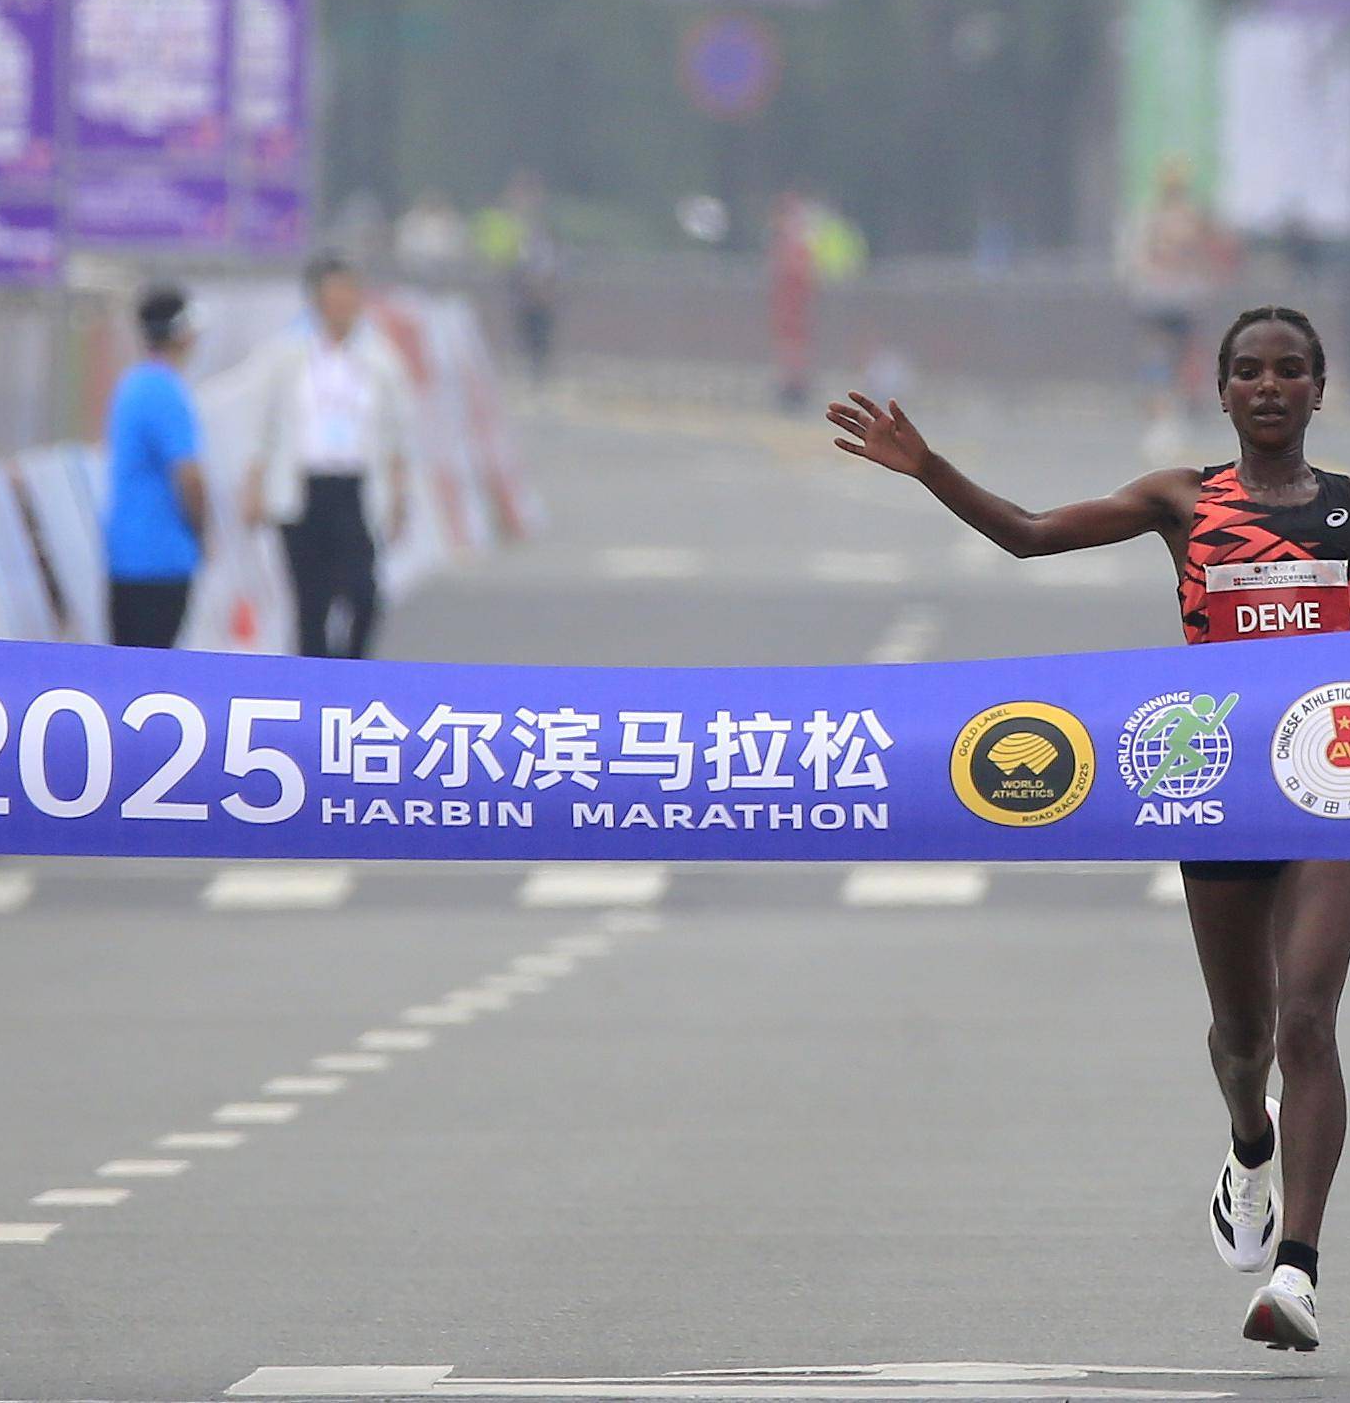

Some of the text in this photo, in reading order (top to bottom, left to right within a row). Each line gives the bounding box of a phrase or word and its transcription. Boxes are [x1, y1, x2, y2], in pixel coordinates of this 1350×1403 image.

[1236, 601, 1322, 633] DEME
[958, 707, 1012, 758] GOLD LABEL
[1117, 691, 1191, 791] WORLD RUNNING
[1277, 712, 1303, 760] CHINESE
[991, 788, 1055, 799] ATHLETICS
[1001, 779, 1045, 789] WORLD
[1022, 762, 1090, 823] ROAD RACE 2025
[321, 798, 890, 831] HARBIN MARATHON
[1134, 799, 1226, 827] AIMS
